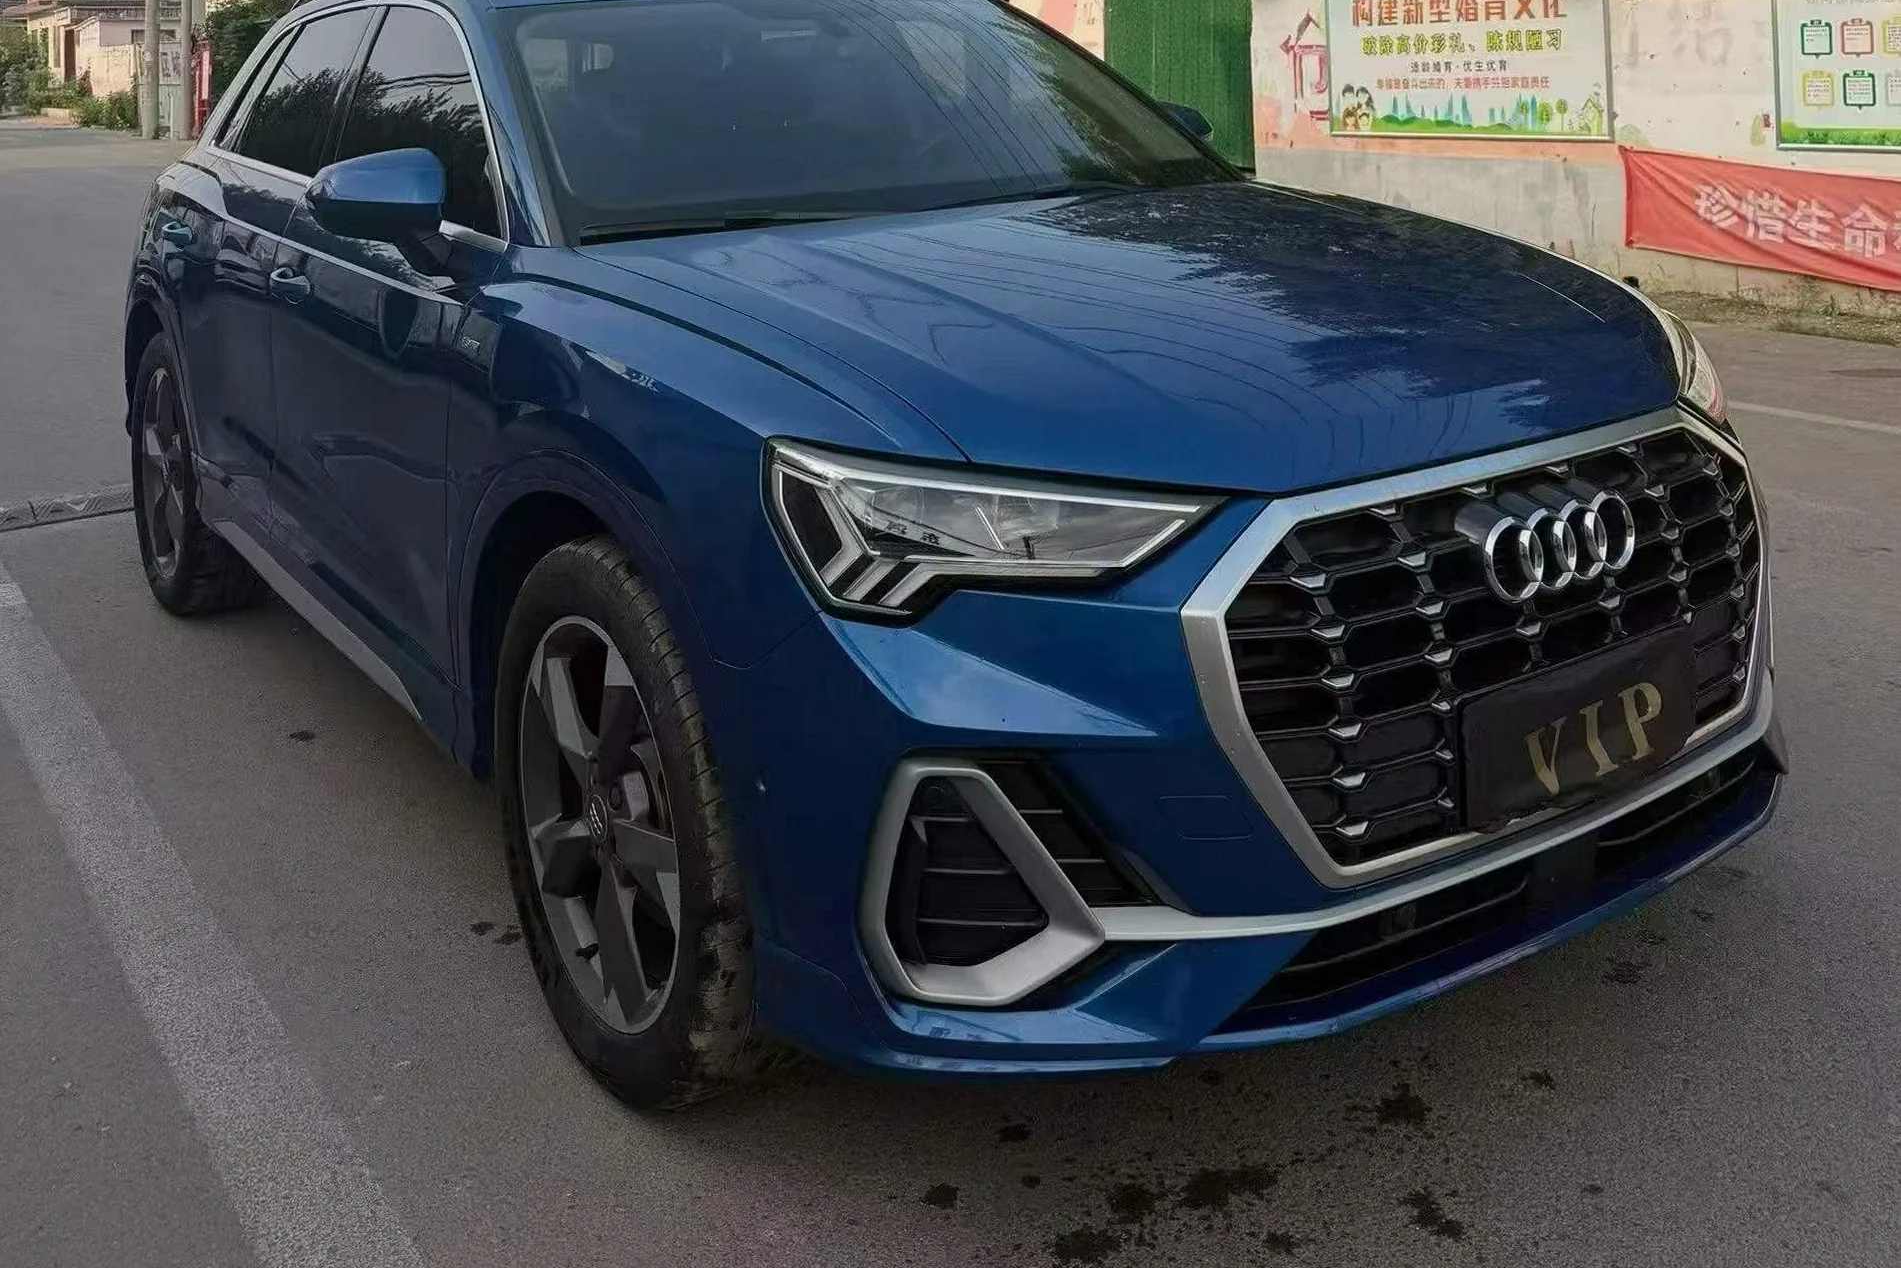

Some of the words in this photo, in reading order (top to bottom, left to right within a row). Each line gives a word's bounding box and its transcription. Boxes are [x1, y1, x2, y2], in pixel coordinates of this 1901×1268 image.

[1693, 184, 1901, 258] 珍惜生命
[1523, 682, 1662, 795] VIP
